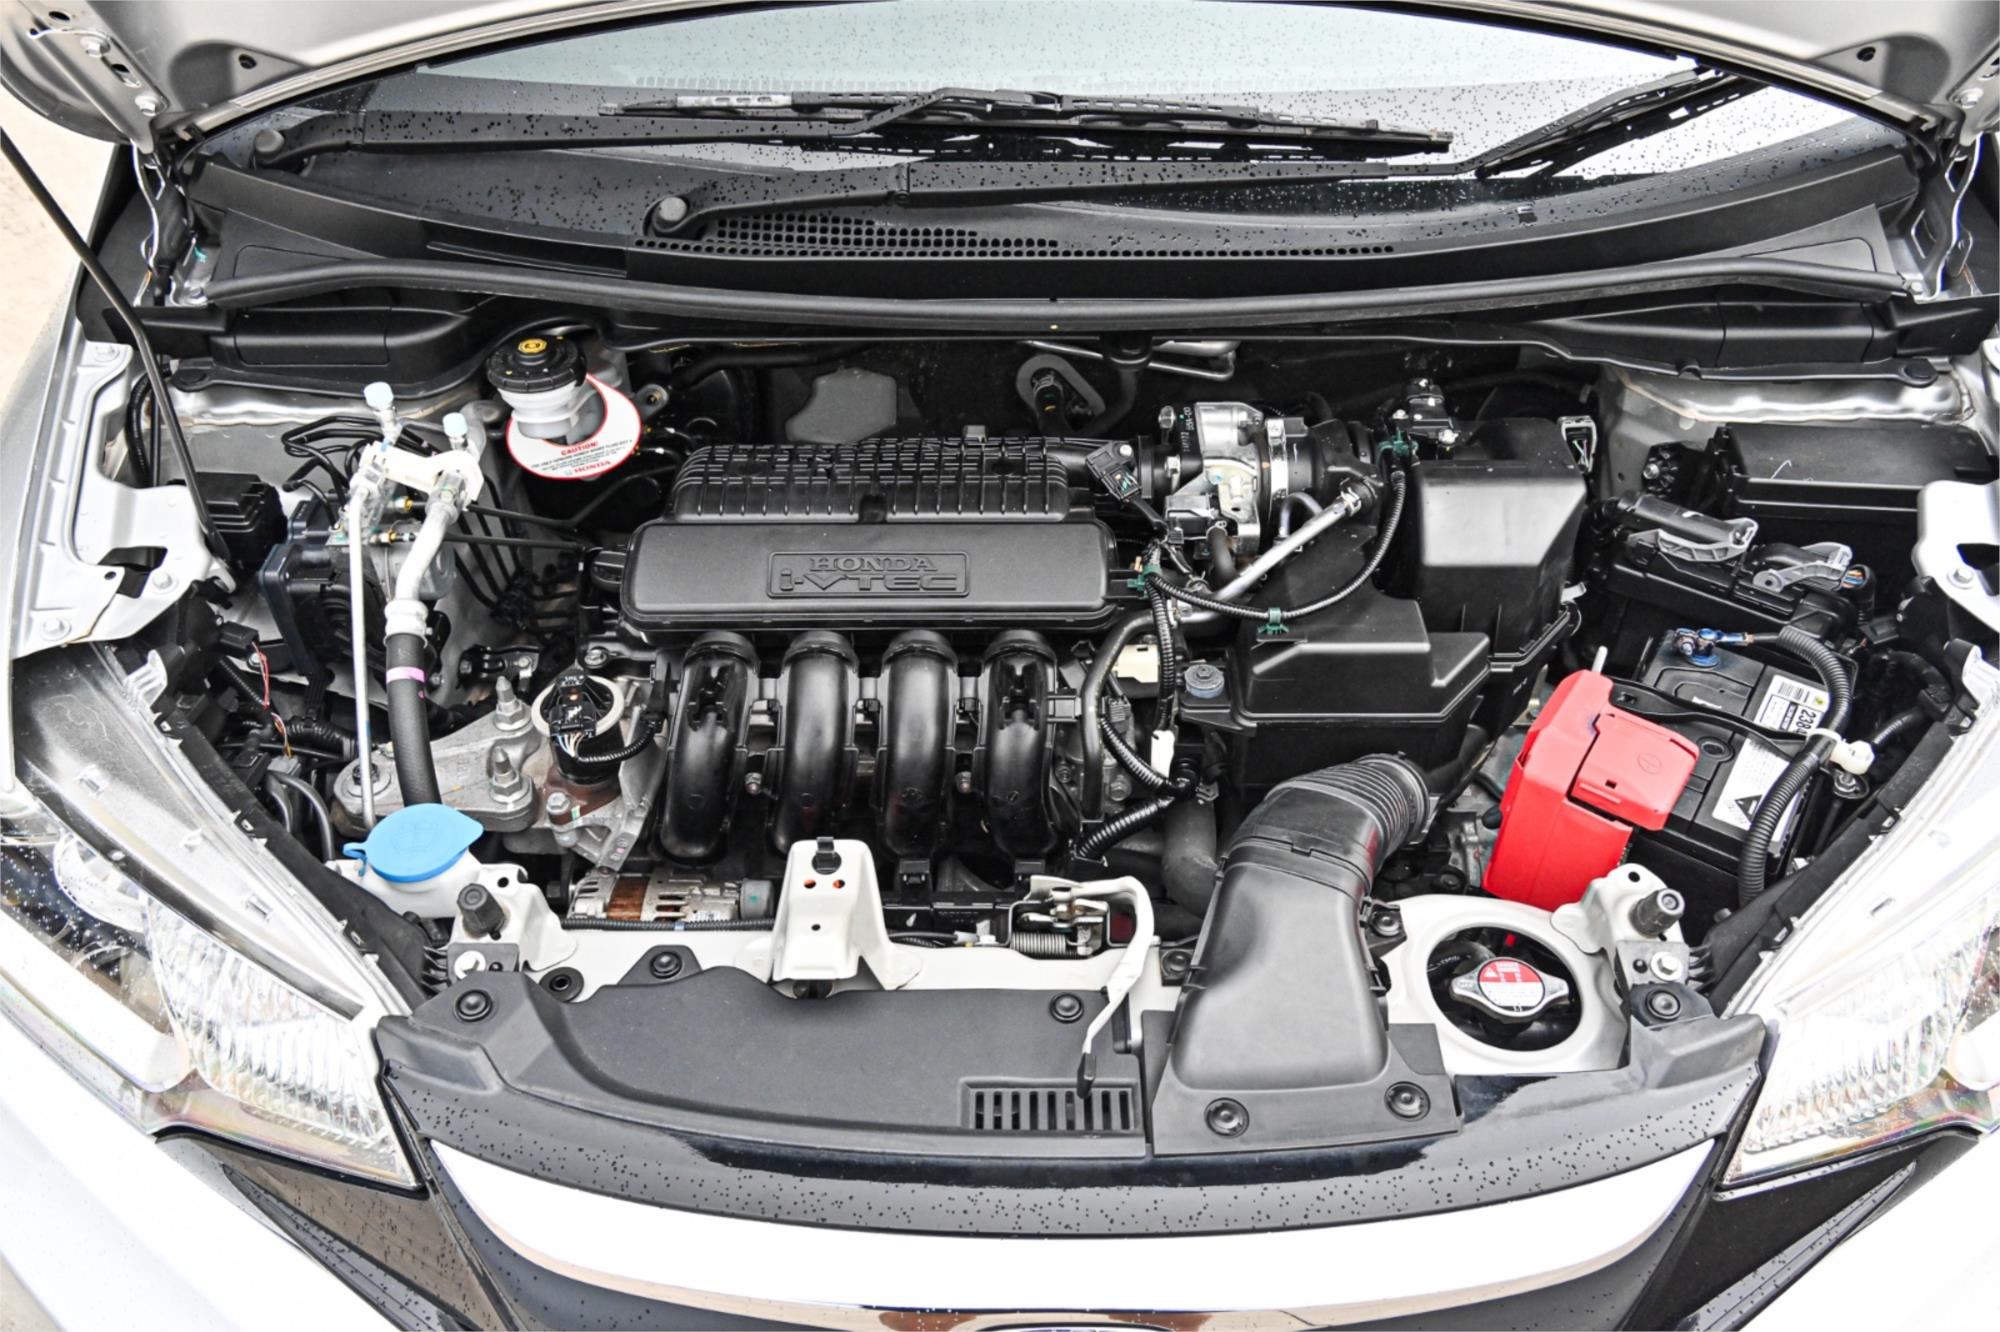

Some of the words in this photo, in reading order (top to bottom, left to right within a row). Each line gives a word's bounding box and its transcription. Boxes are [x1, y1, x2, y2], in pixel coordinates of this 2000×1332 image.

[560, 441, 600, 456] CAUTION!
[574, 461, 611, 472] HONDA
[809, 557, 938, 572] HONDA
[779, 568, 958, 591] i-VTEC
